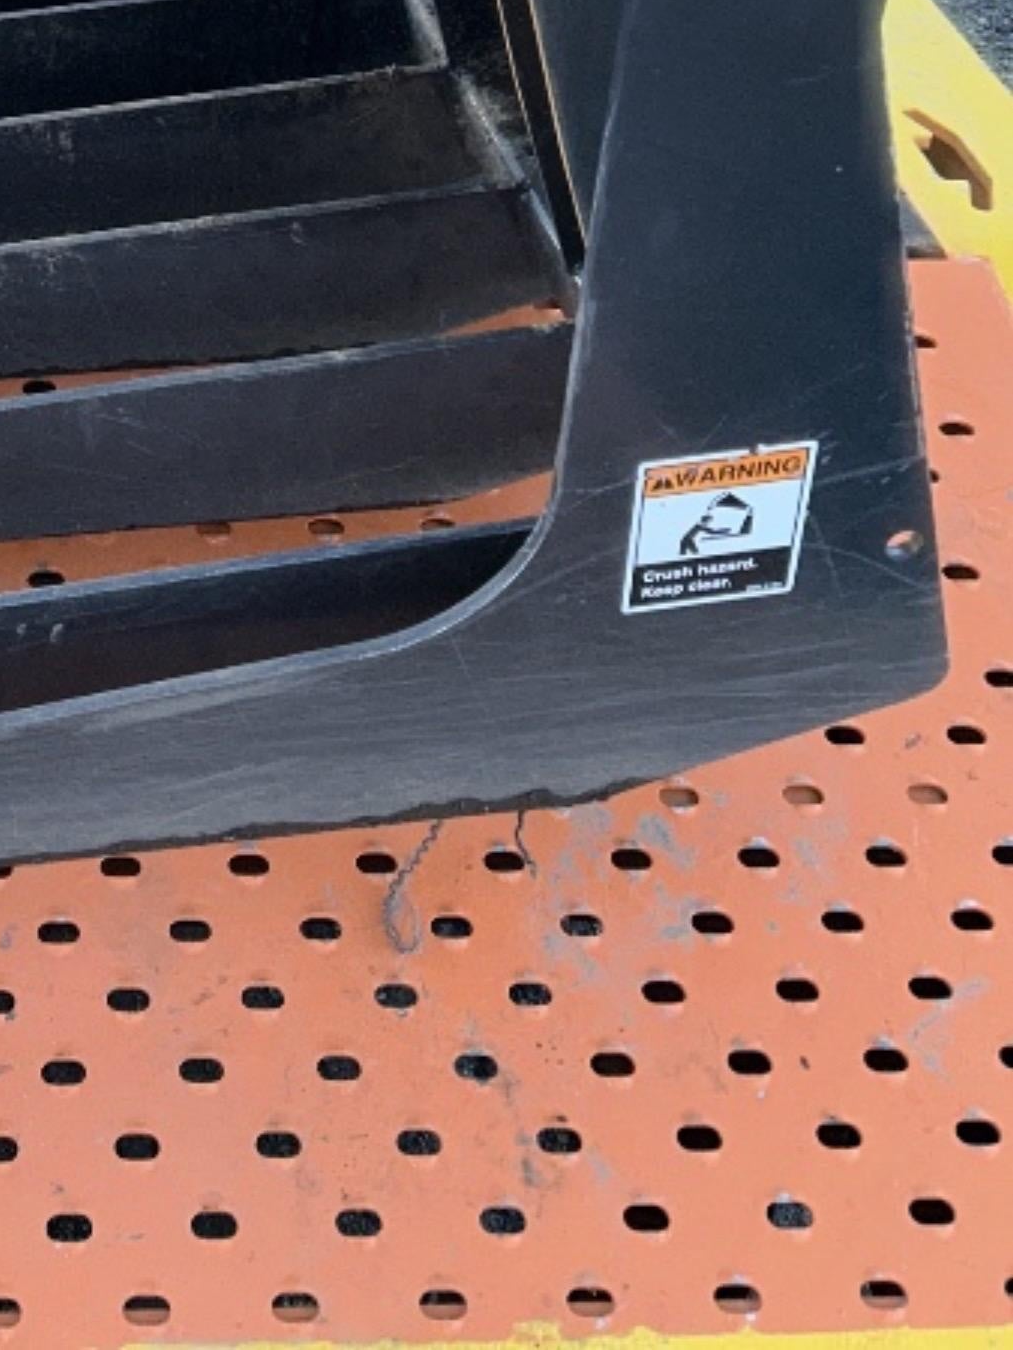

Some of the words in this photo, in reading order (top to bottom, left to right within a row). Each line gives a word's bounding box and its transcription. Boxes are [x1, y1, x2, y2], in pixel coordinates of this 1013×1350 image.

[675, 456, 803, 489] WARNING
[643, 566, 693, 583] Crush
[640, 583, 684, 599] Keep
